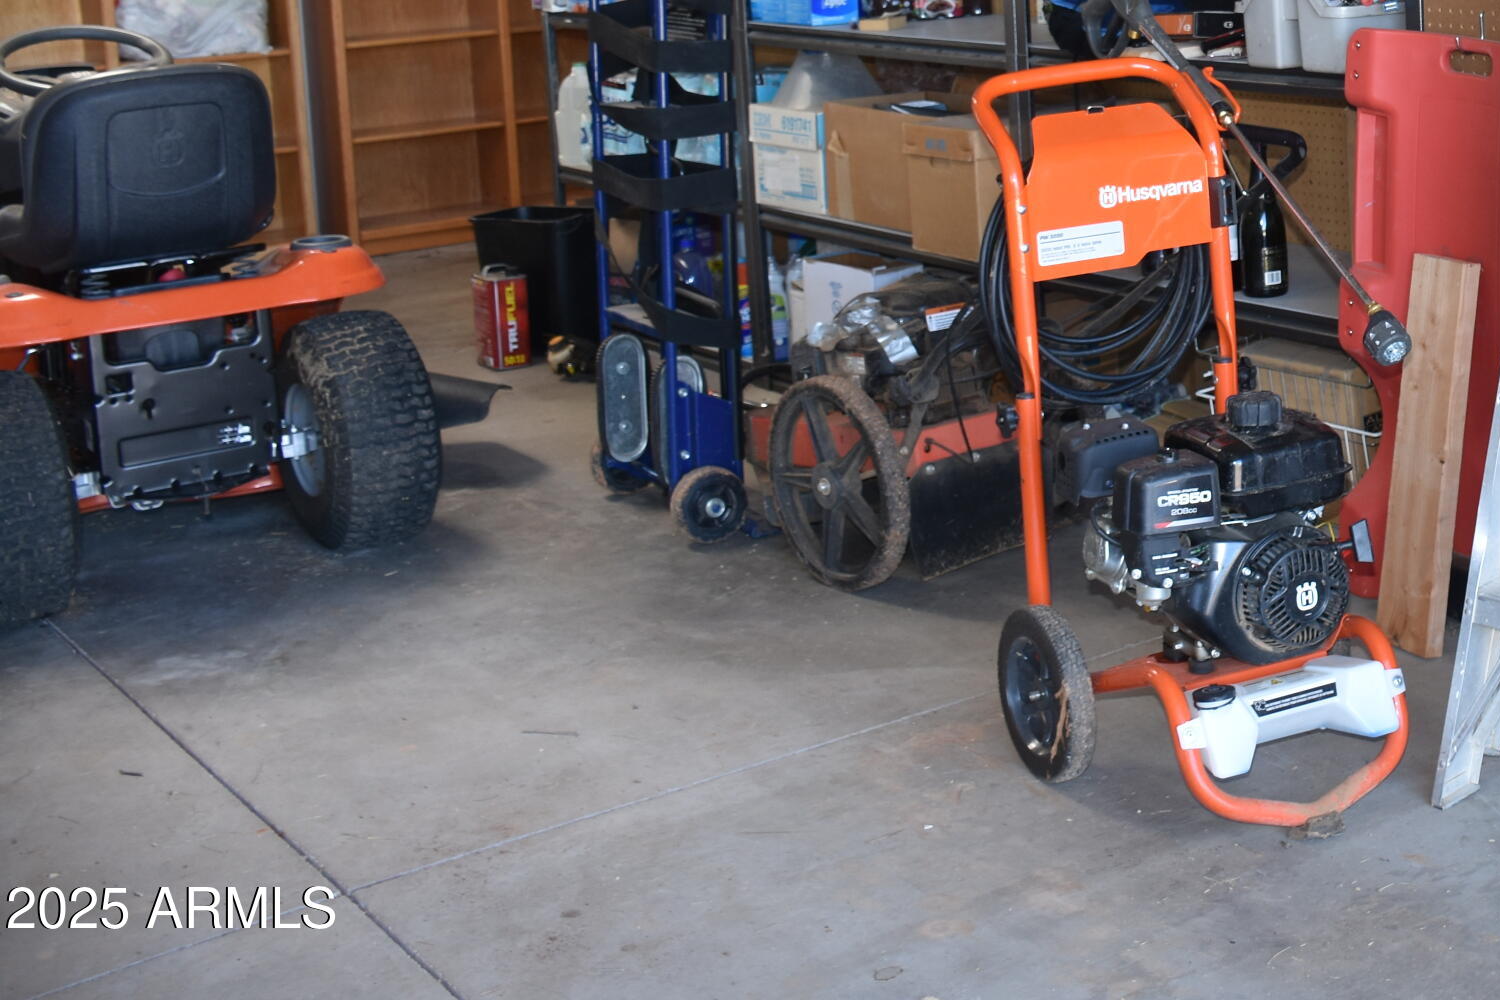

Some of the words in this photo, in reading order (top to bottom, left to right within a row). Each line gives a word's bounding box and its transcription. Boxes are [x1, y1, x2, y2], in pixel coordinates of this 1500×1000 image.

[1118, 179, 1203, 203] Husqvarna
[1157, 490, 1212, 508] CR950
[1170, 507, 1198, 516] 208cc
